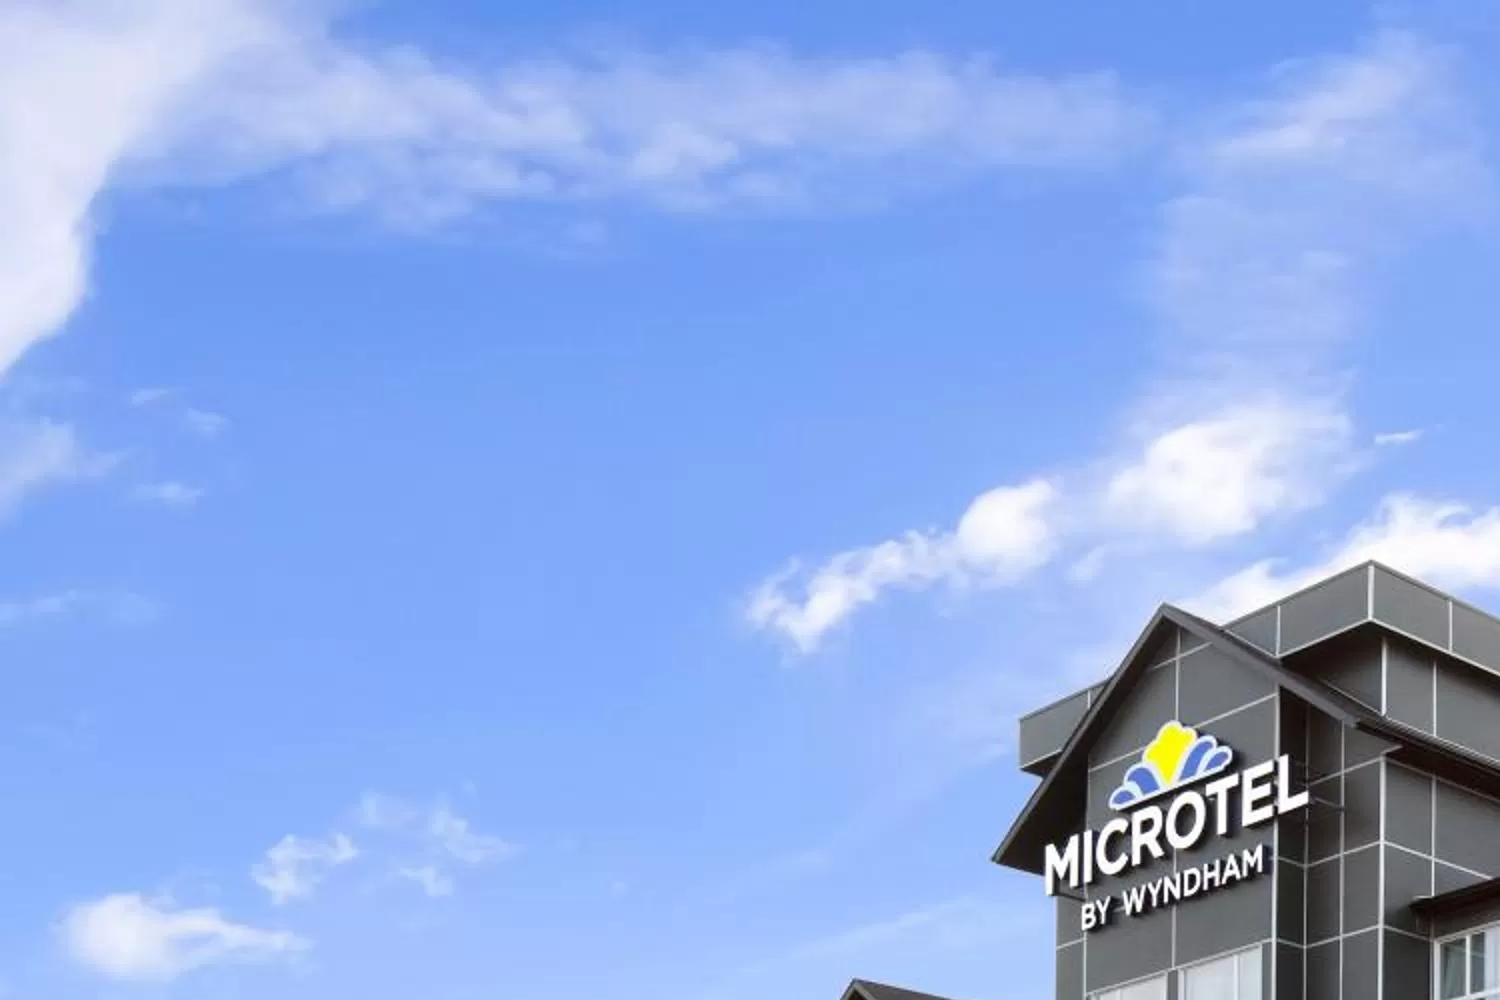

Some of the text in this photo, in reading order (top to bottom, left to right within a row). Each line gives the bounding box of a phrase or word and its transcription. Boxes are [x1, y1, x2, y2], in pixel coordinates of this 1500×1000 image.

[1045, 754, 1309, 896] MICROTEL
[1081, 844, 1264, 931] BY WYNDHAM
